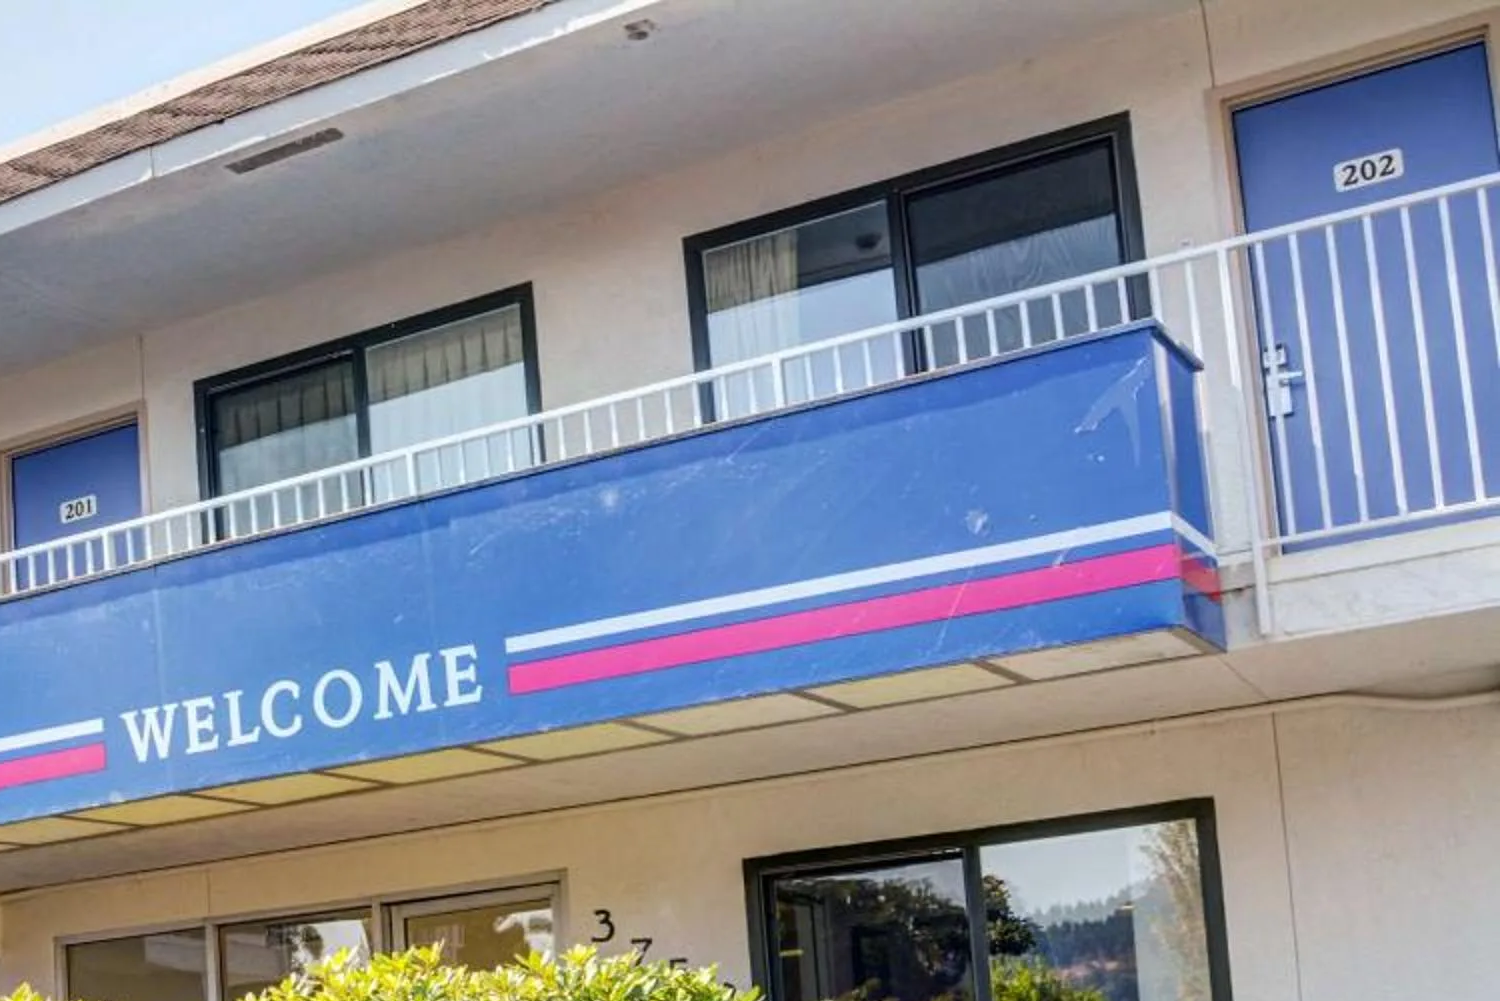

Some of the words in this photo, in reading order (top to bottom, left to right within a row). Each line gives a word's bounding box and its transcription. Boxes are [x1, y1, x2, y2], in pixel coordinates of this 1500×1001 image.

[1342, 154, 1395, 187] 202
[65, 498, 92, 520] 201
[120, 644, 483, 763] WELCOME
